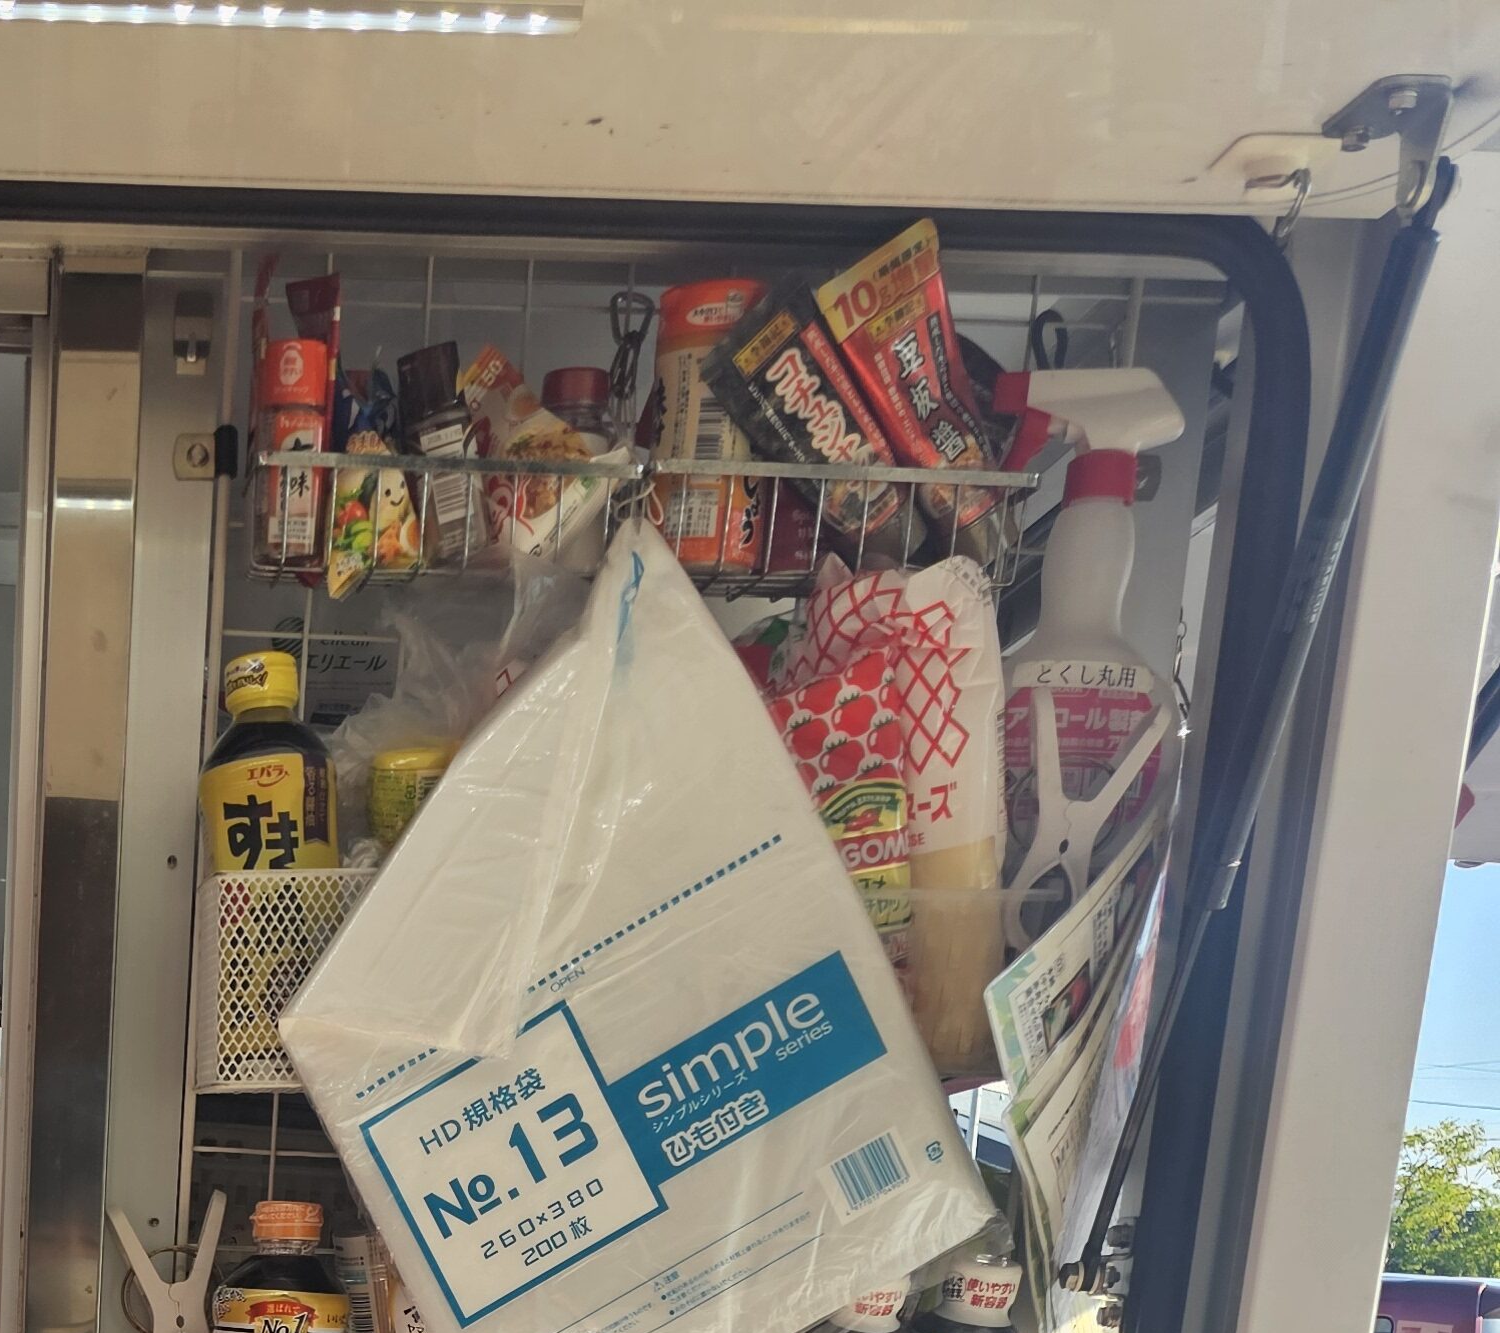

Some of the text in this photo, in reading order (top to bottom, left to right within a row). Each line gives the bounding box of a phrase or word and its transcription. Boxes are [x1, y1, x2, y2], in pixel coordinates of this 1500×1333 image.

[304, 653, 388, 674] エリエール
[1036, 664, 1137, 688] とくし丸用
[247, 764, 290, 783] エバラ
[549, 966, 587, 993] OPEN
[636, 993, 825, 1120] simple
[775, 1020, 834, 1062] series
[418, 1067, 547, 1155] HD規格袋
[651, 1069, 749, 1134] シンプルシリーズ
[661, 1089, 770, 1167] ひも付き
[422, 1092, 600, 1239] No.13
[479, 1178, 604, 1260] 260×380
[520, 1216, 594, 1267] 200枚
[966, 1277, 1016, 1296] 使いやすい
[970, 1294, 1008, 1309] 新容器
